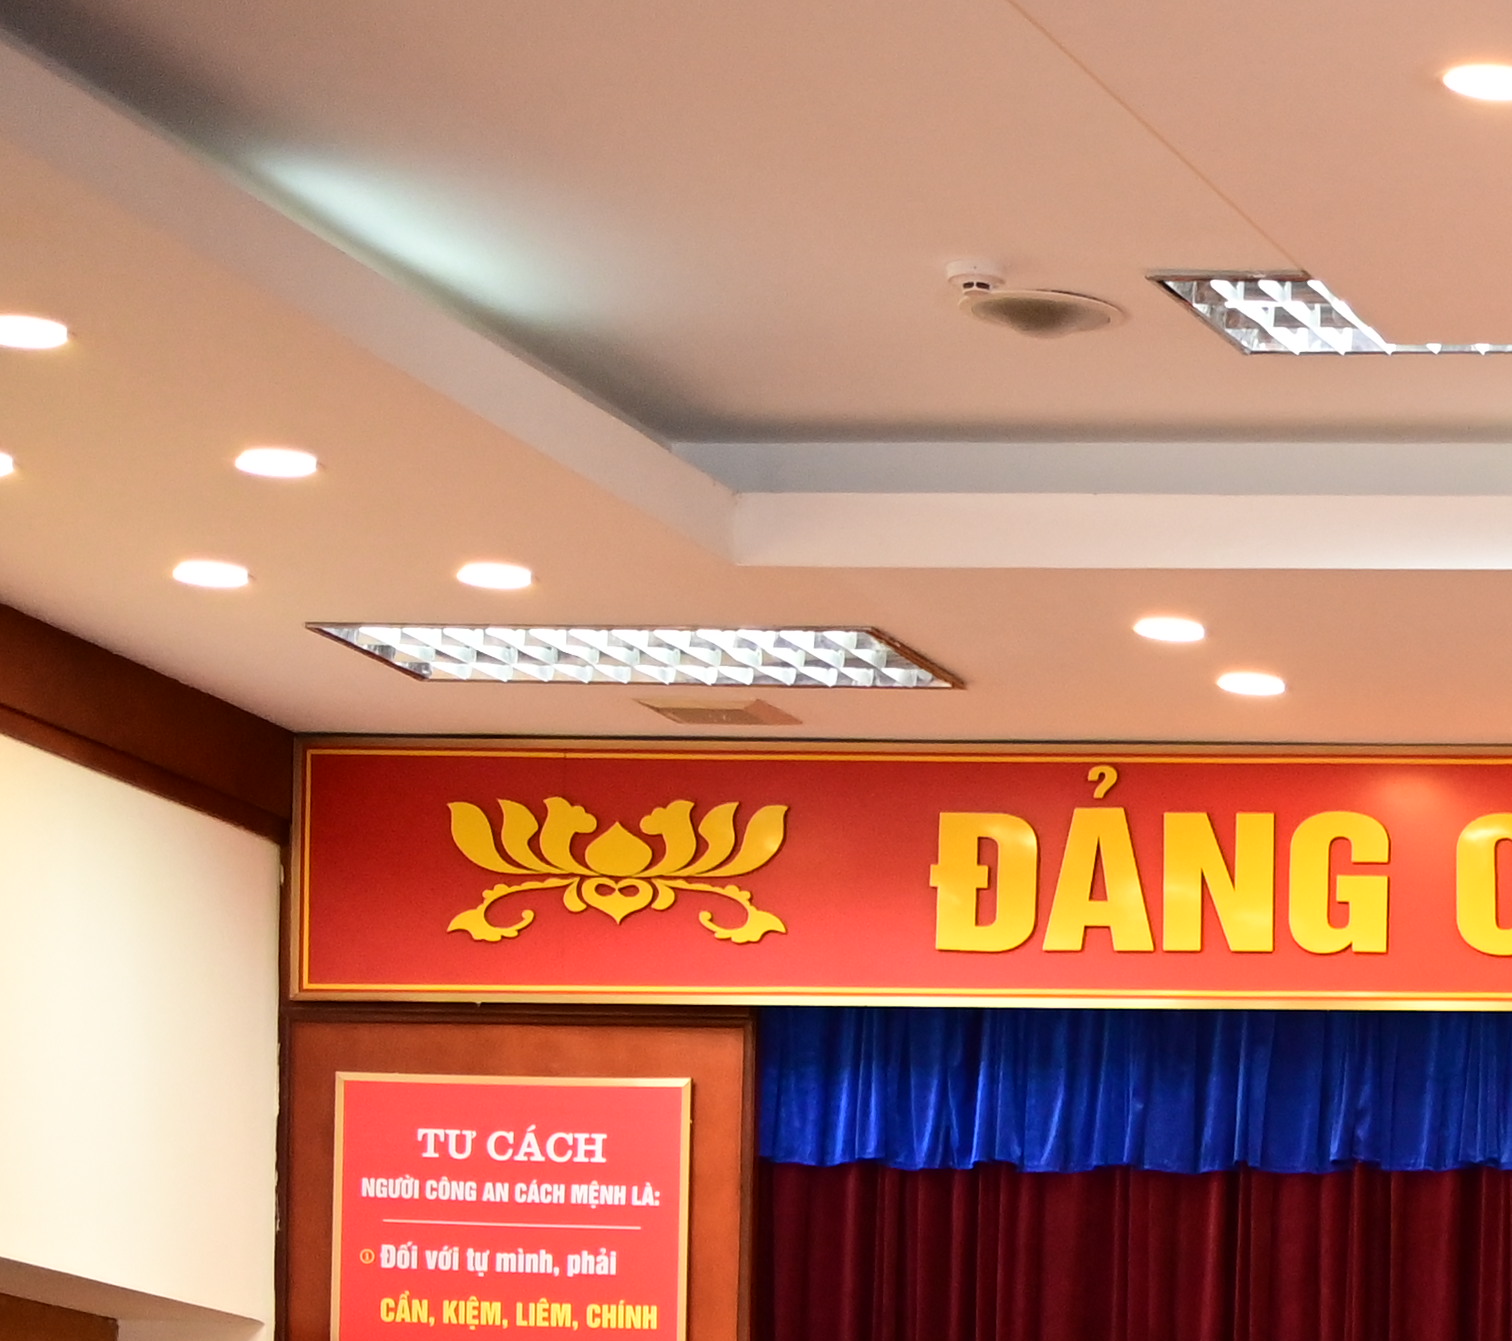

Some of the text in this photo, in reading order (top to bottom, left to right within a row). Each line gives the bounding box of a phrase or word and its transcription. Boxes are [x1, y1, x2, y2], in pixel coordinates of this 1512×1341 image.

[928, 765, 1394, 956] ĐẢNG
[417, 1124, 608, 1163] TƯ CÁCH
[361, 1174, 661, 1209] NGƯỜI CÔNG AN CÁCH MỆNH LÀ:
[379, 1240, 617, 1278] Đối với tự mình, phải
[442, 1295, 509, 1331] KIỆM,
[515, 1297, 579, 1331] LIÊM,
[586, 1299, 658, 1330] CHÍNH
